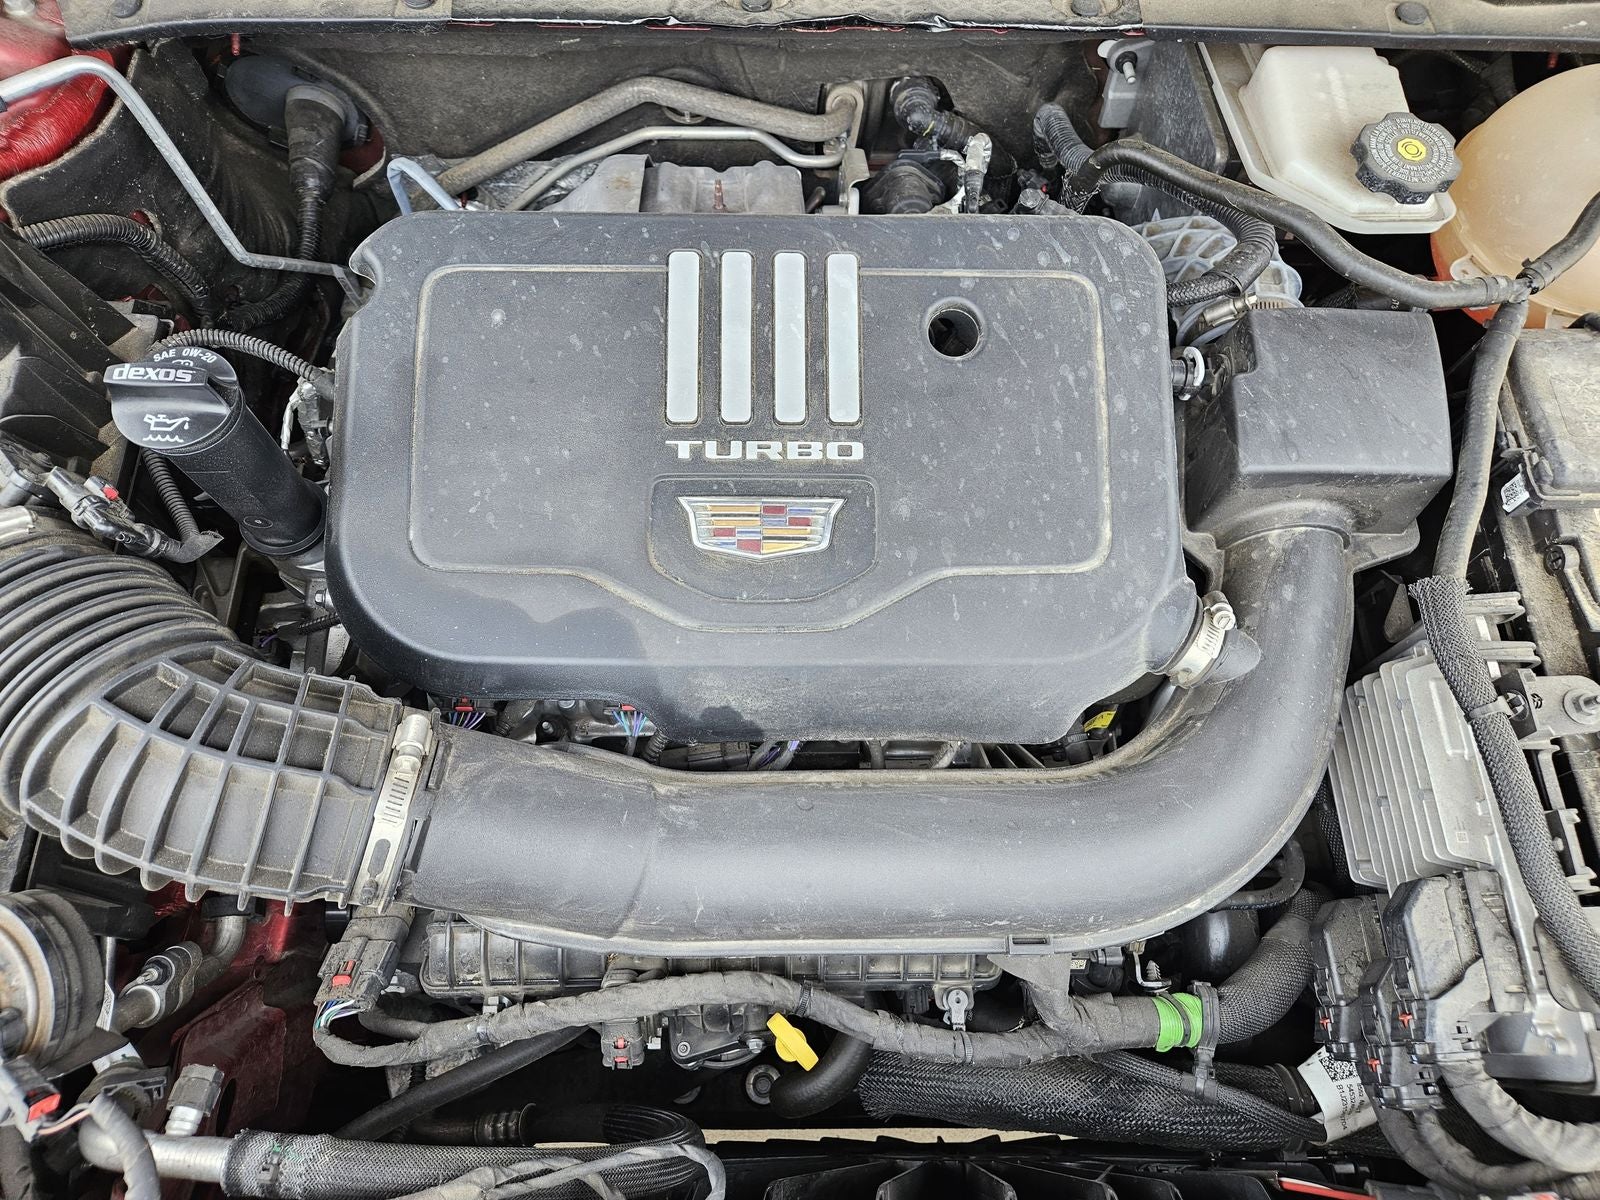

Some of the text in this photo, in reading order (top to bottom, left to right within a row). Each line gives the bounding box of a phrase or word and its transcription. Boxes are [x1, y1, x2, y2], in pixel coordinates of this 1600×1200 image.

[153, 348, 217, 363] SAE 0W-20
[112, 363, 193, 383] dexos
[665, 440, 864, 460] TURBO
